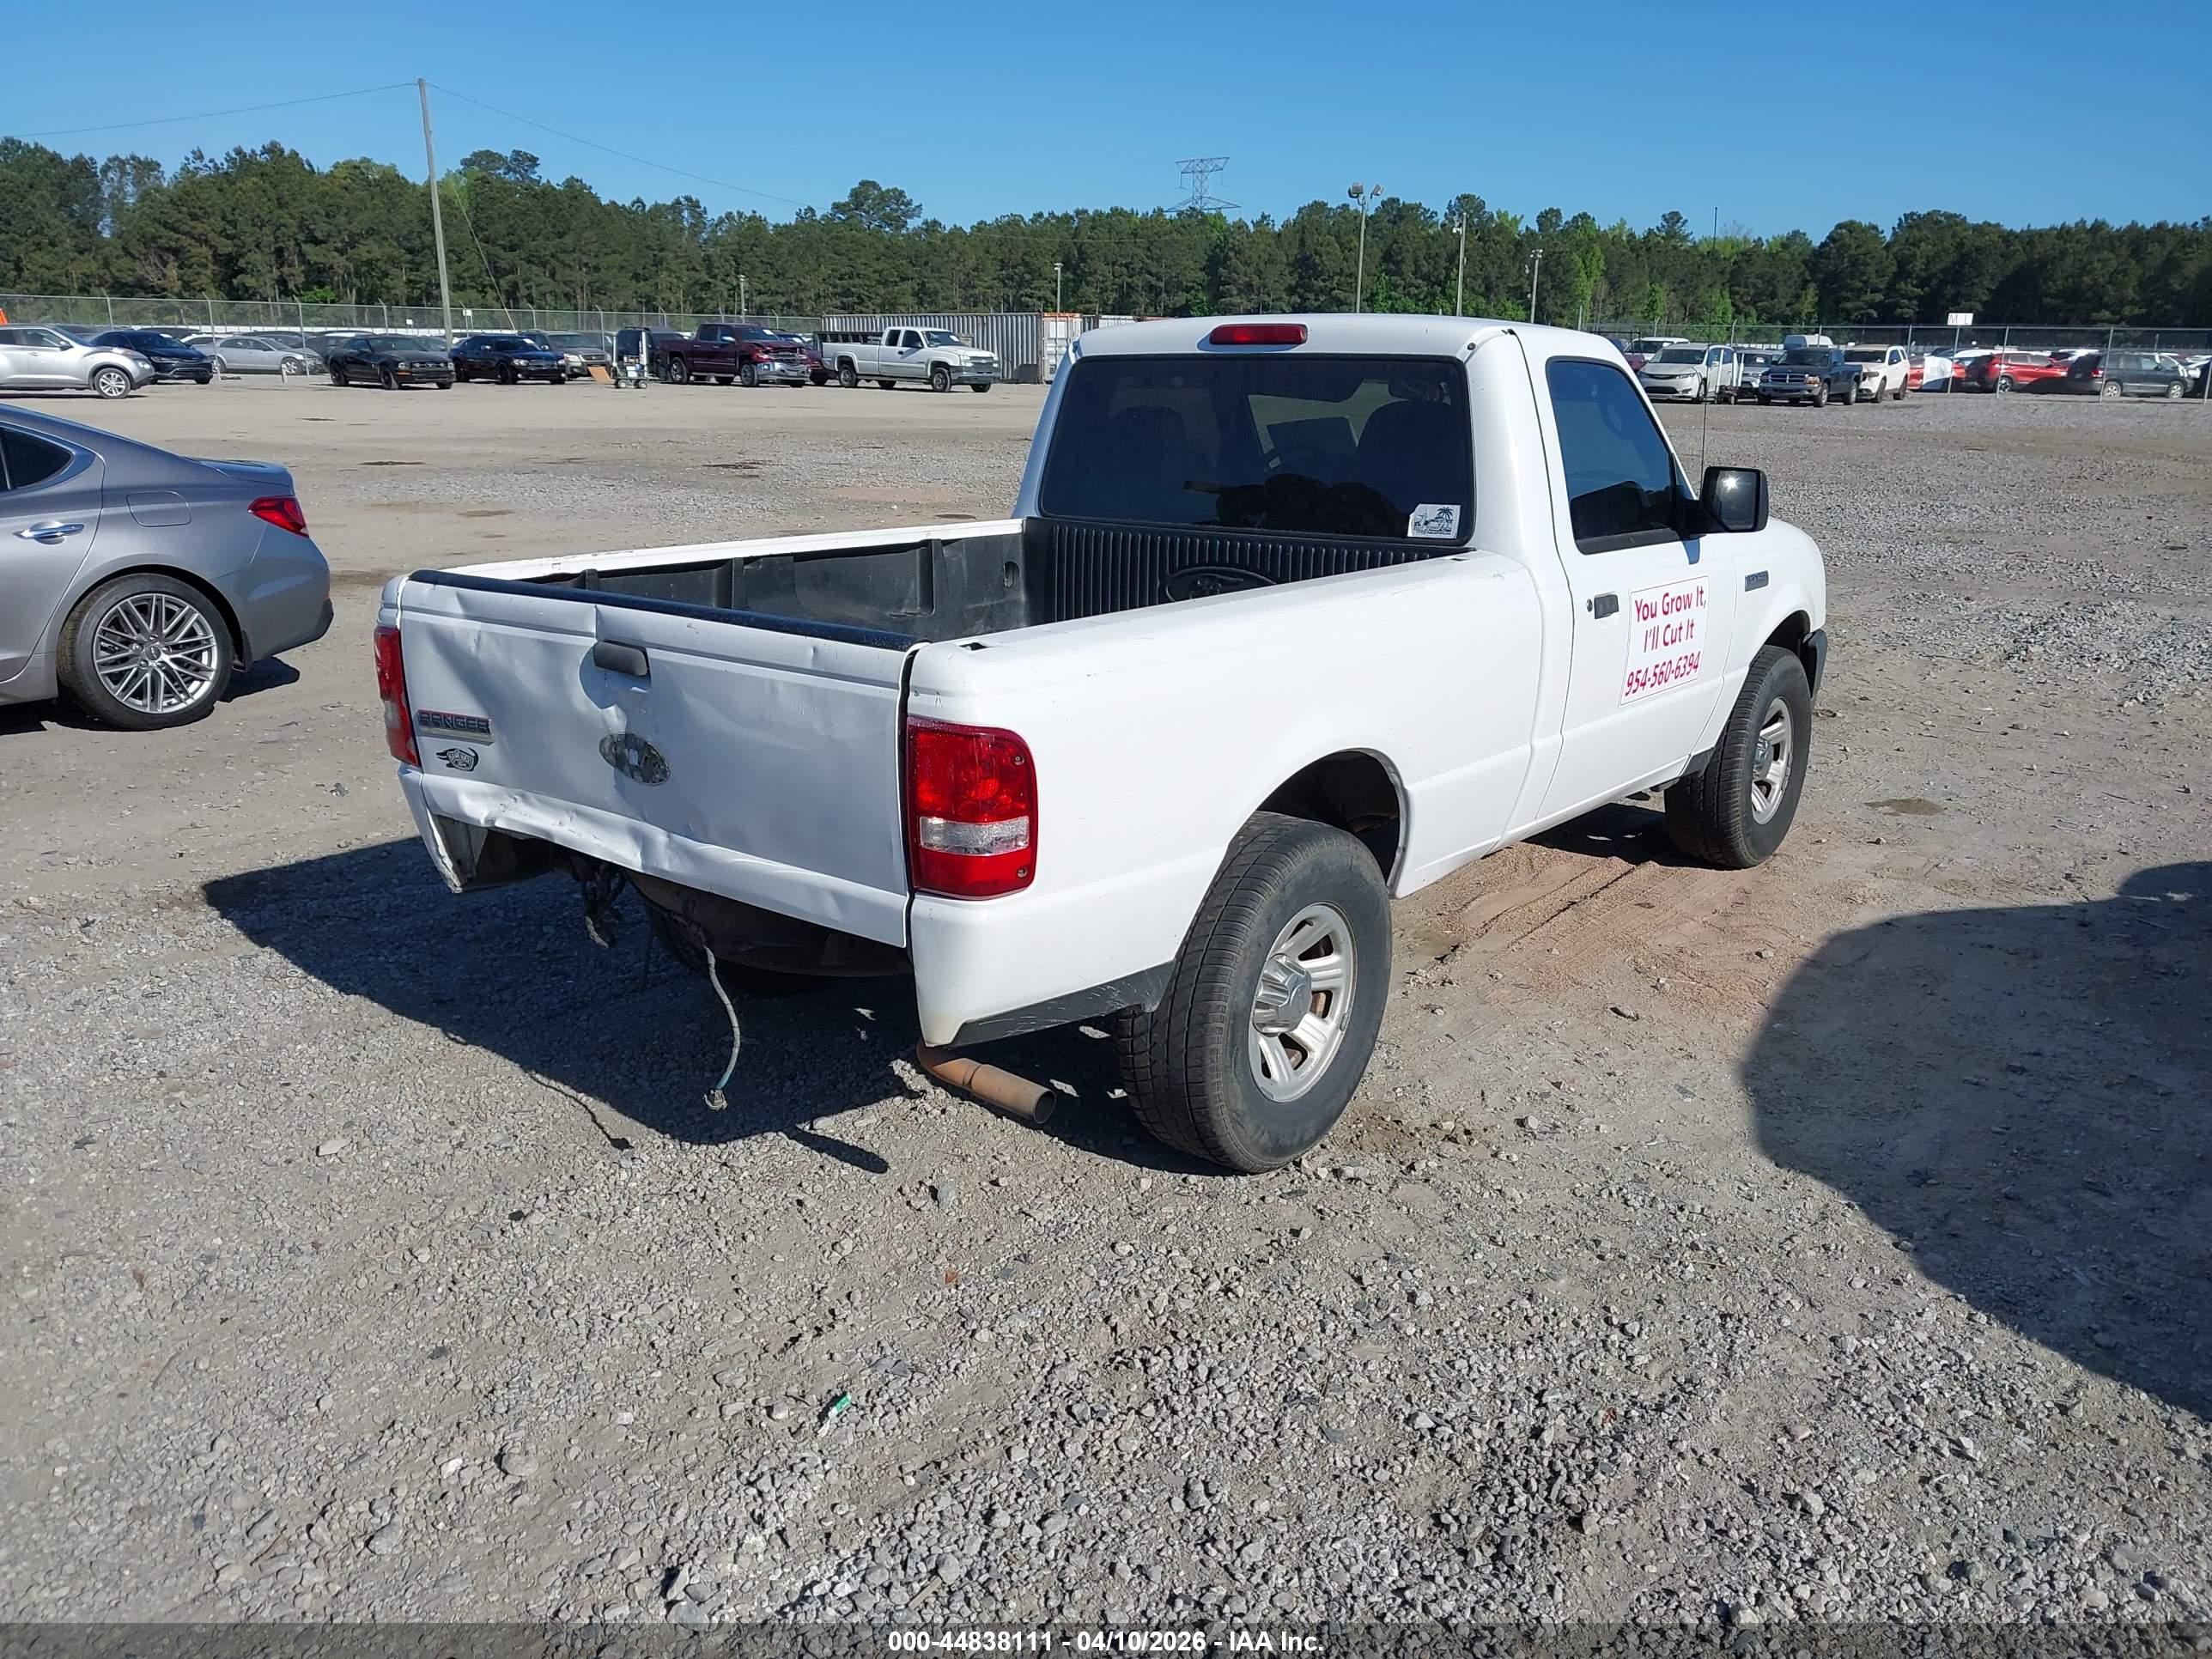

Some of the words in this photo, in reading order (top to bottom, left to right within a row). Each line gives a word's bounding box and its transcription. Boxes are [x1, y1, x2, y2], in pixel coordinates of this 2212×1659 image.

[1635, 599, 1657, 623] You
[1662, 592, 1692, 616] Grow
[1696, 586, 1707, 609] It,
[1644, 625, 1660, 653] I'll
[1662, 622, 1683, 647] Cut
[1686, 618, 1695, 640] It
[1625, 651, 1701, 696] 954-560-6394
[417, 711, 490, 734] RANGER
